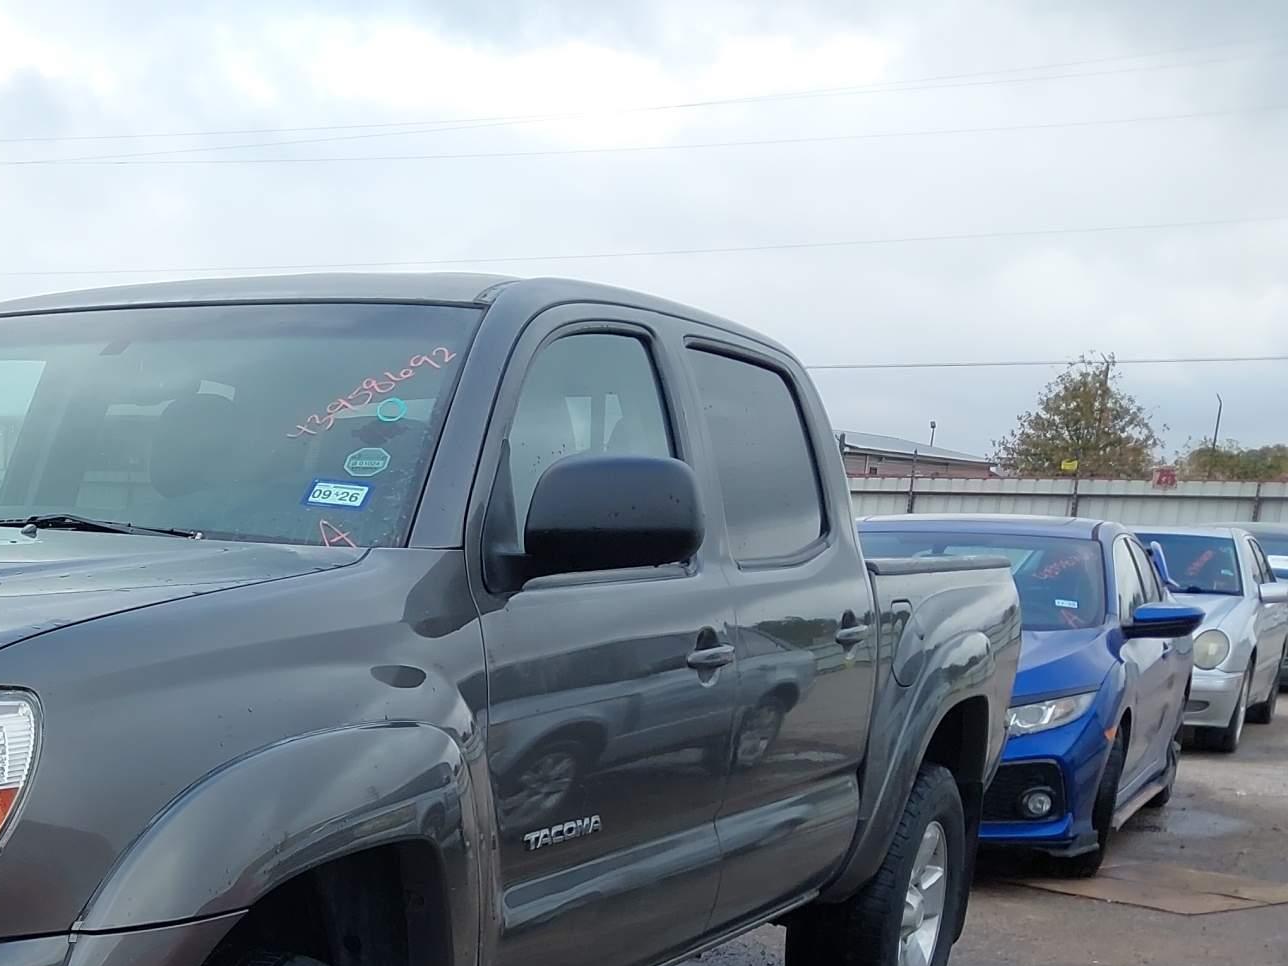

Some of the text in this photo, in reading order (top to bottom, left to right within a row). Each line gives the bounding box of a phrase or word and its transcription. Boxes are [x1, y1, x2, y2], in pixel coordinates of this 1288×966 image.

[286, 346, 457, 438] 43958692
[311, 488, 361, 503] 09 26
[523, 814, 602, 851] TACOMA
